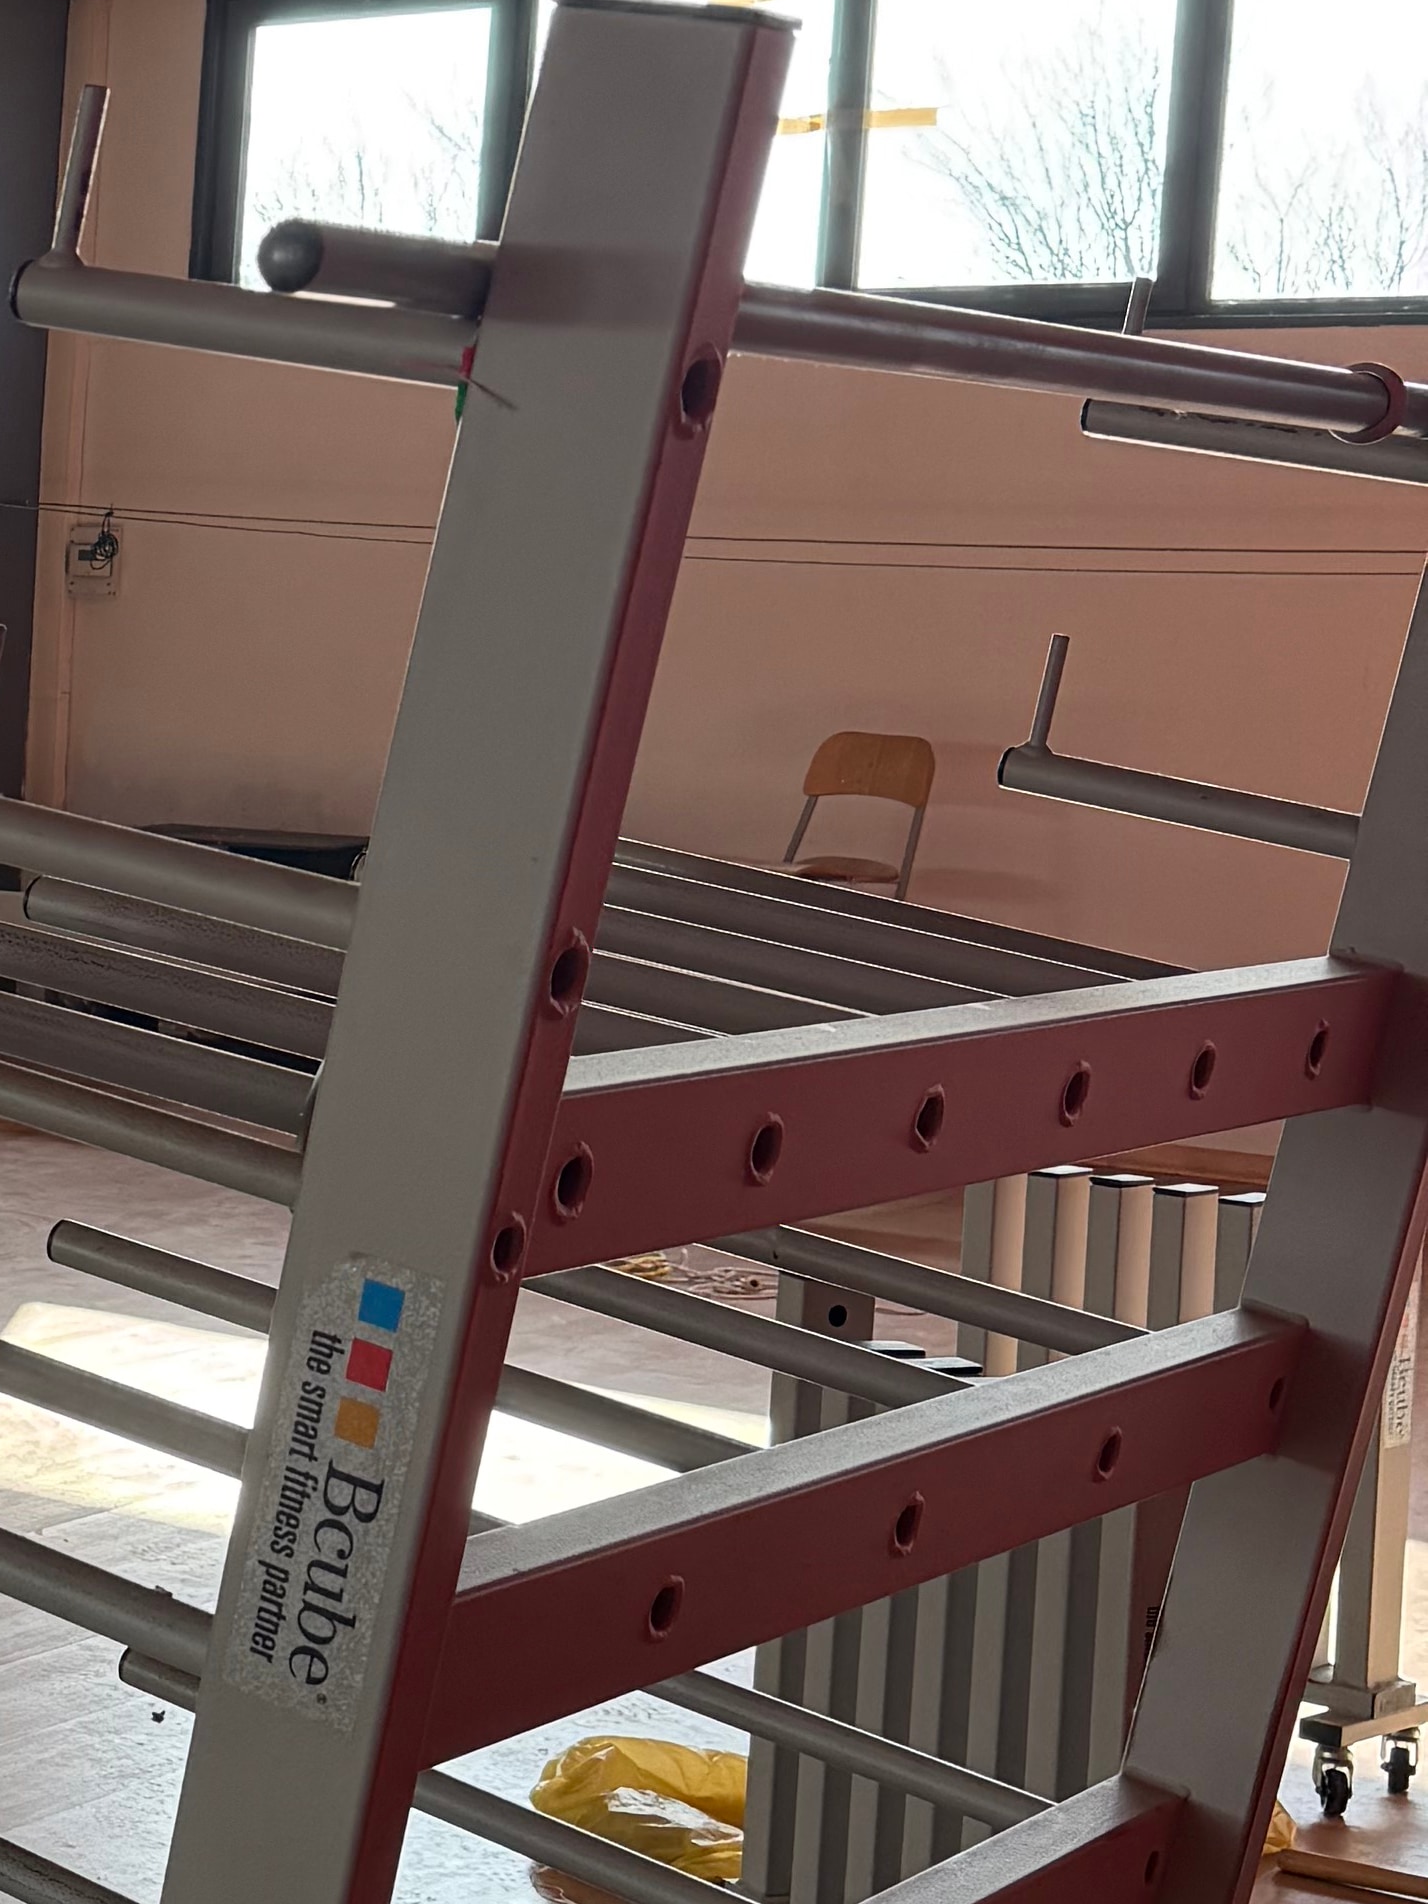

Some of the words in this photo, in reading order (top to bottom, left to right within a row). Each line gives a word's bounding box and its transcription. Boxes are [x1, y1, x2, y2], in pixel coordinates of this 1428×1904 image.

[306, 1330, 346, 1376] the
[288, 1379, 327, 1462] smart
[270, 1464, 320, 1559] fitness
[249, 1559, 291, 1665] partner
[289, 1459, 385, 1686] Bcube
